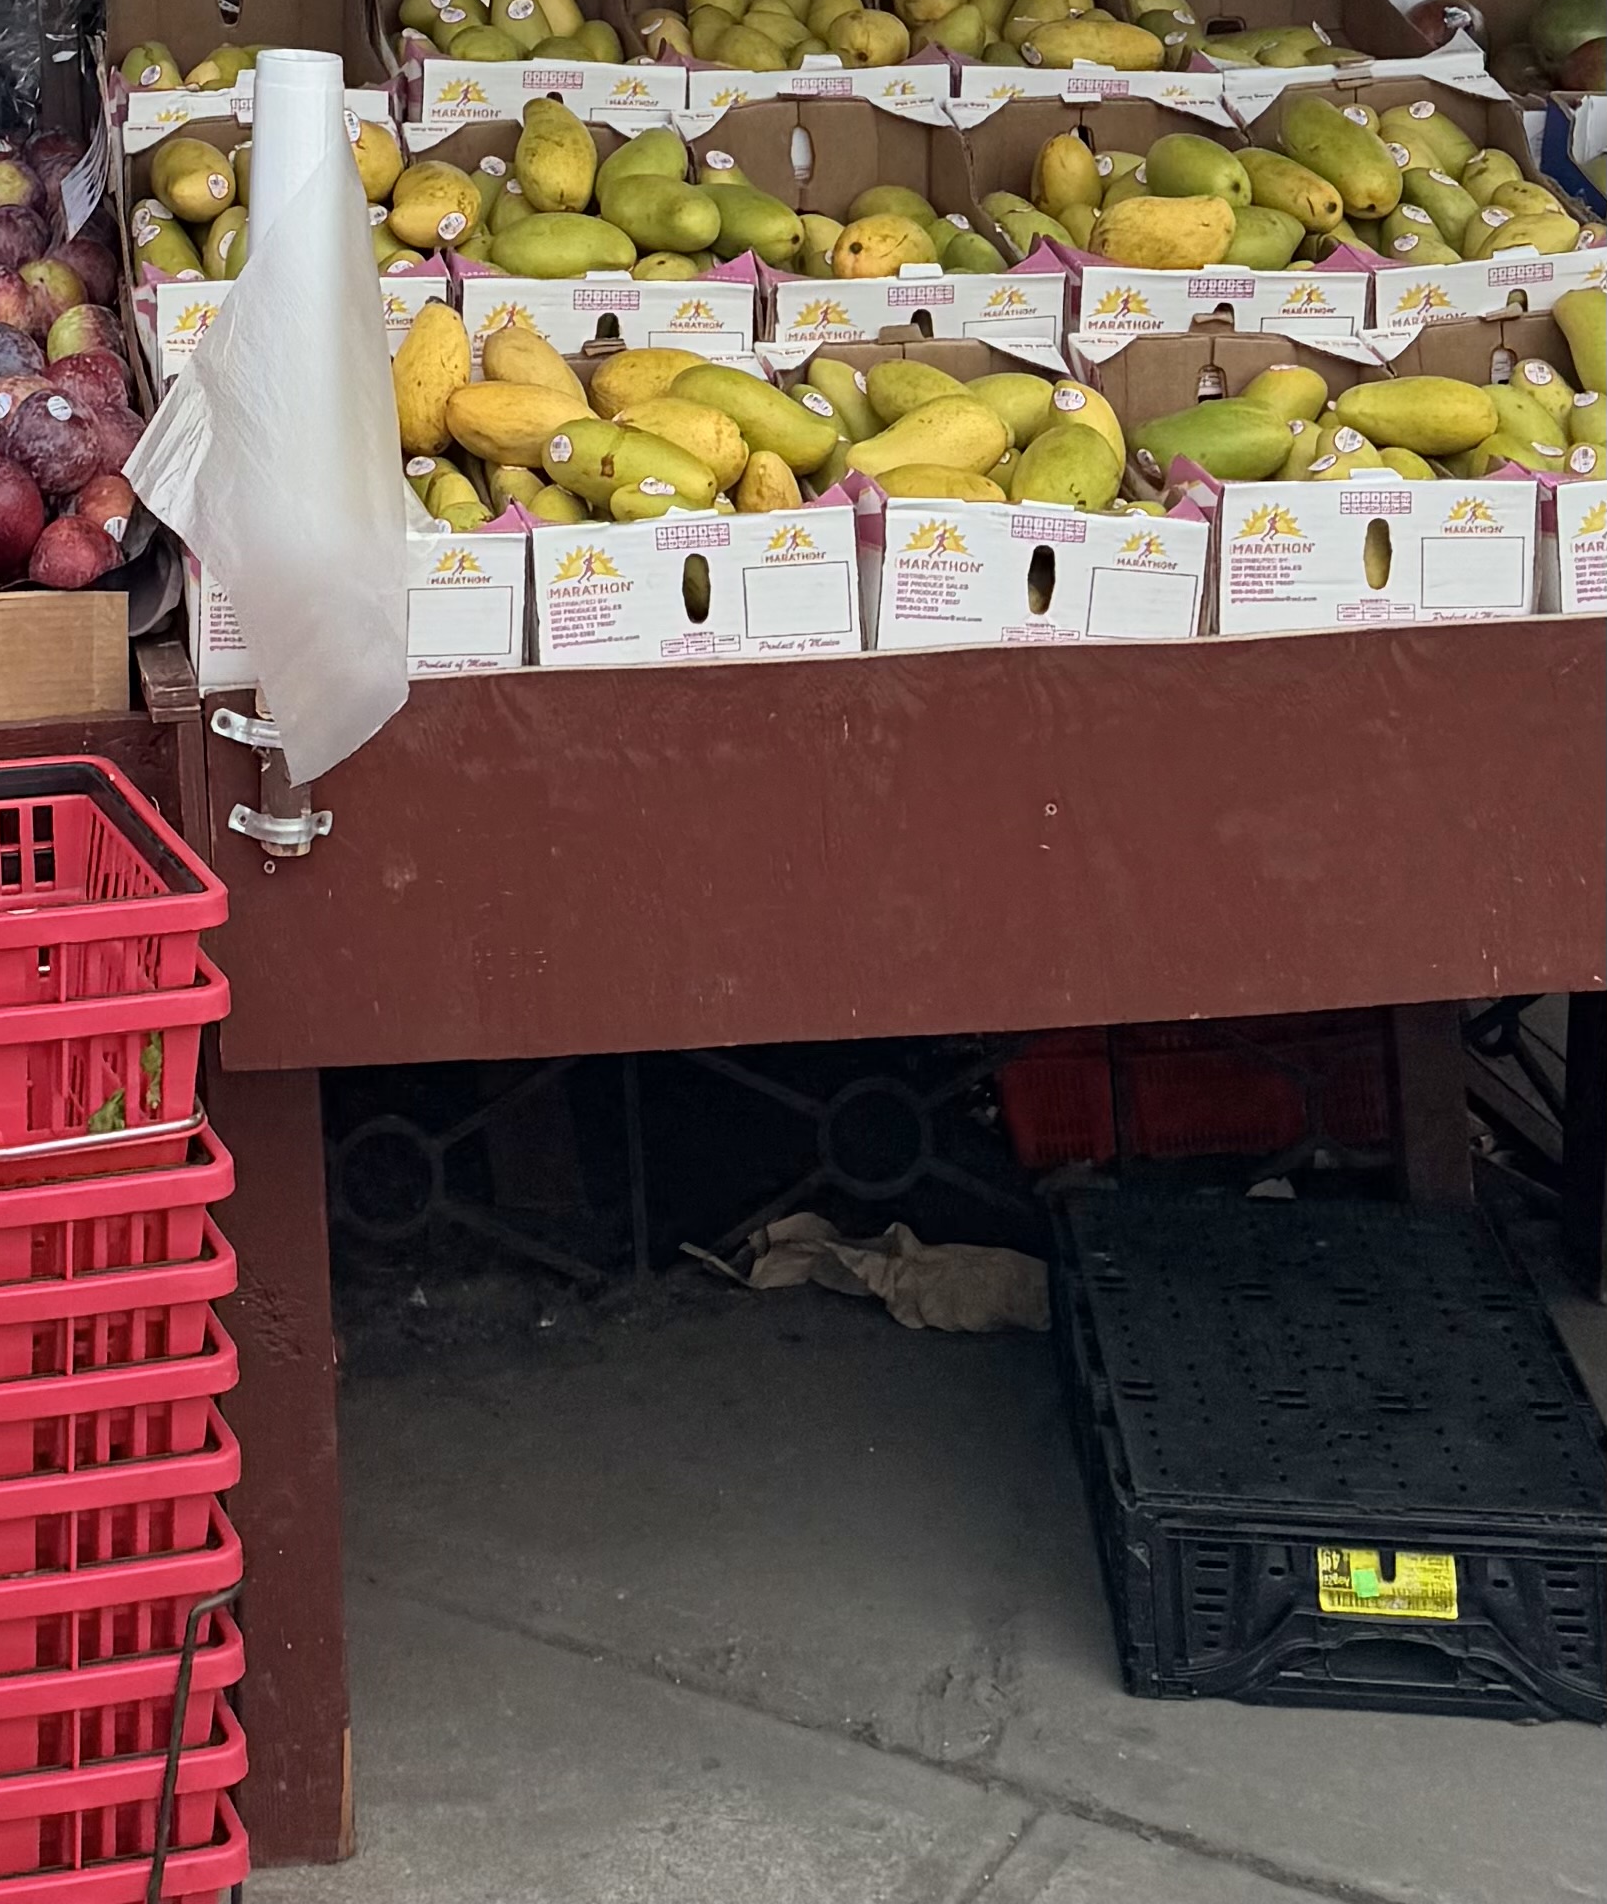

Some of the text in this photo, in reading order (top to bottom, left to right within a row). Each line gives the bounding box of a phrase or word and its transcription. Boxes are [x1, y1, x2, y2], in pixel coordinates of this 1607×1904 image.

[431, 108, 501, 120] MARATHON
[1087, 320, 1164, 332] MARATHON
[1232, 543, 1316, 555] MARATHON
[898, 558, 984, 573] MARATHON
[1117, 557, 1179, 570] MARATHON
[549, 581, 634, 599] MARATHON
